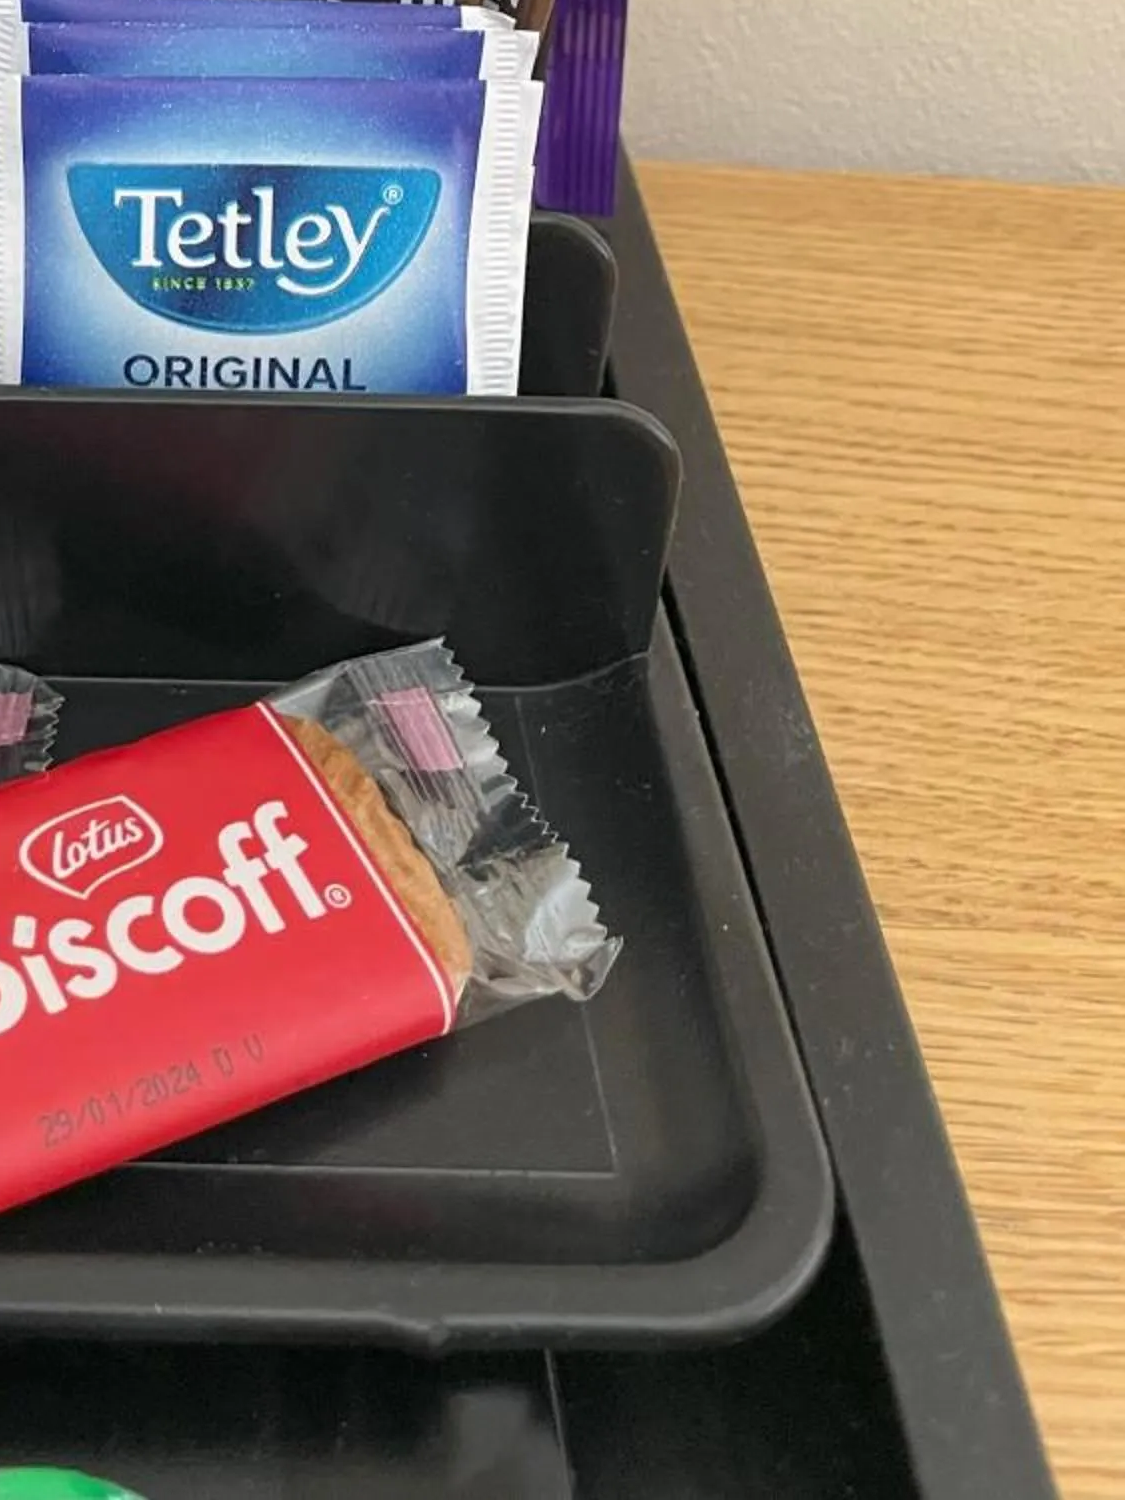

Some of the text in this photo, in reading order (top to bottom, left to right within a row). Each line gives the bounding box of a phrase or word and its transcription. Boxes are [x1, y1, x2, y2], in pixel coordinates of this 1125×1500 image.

[152, 275, 207, 291] SINCE
[123, 354, 367, 392] ORIGINAL
[37, 1059, 204, 1148] 29/01/2024
